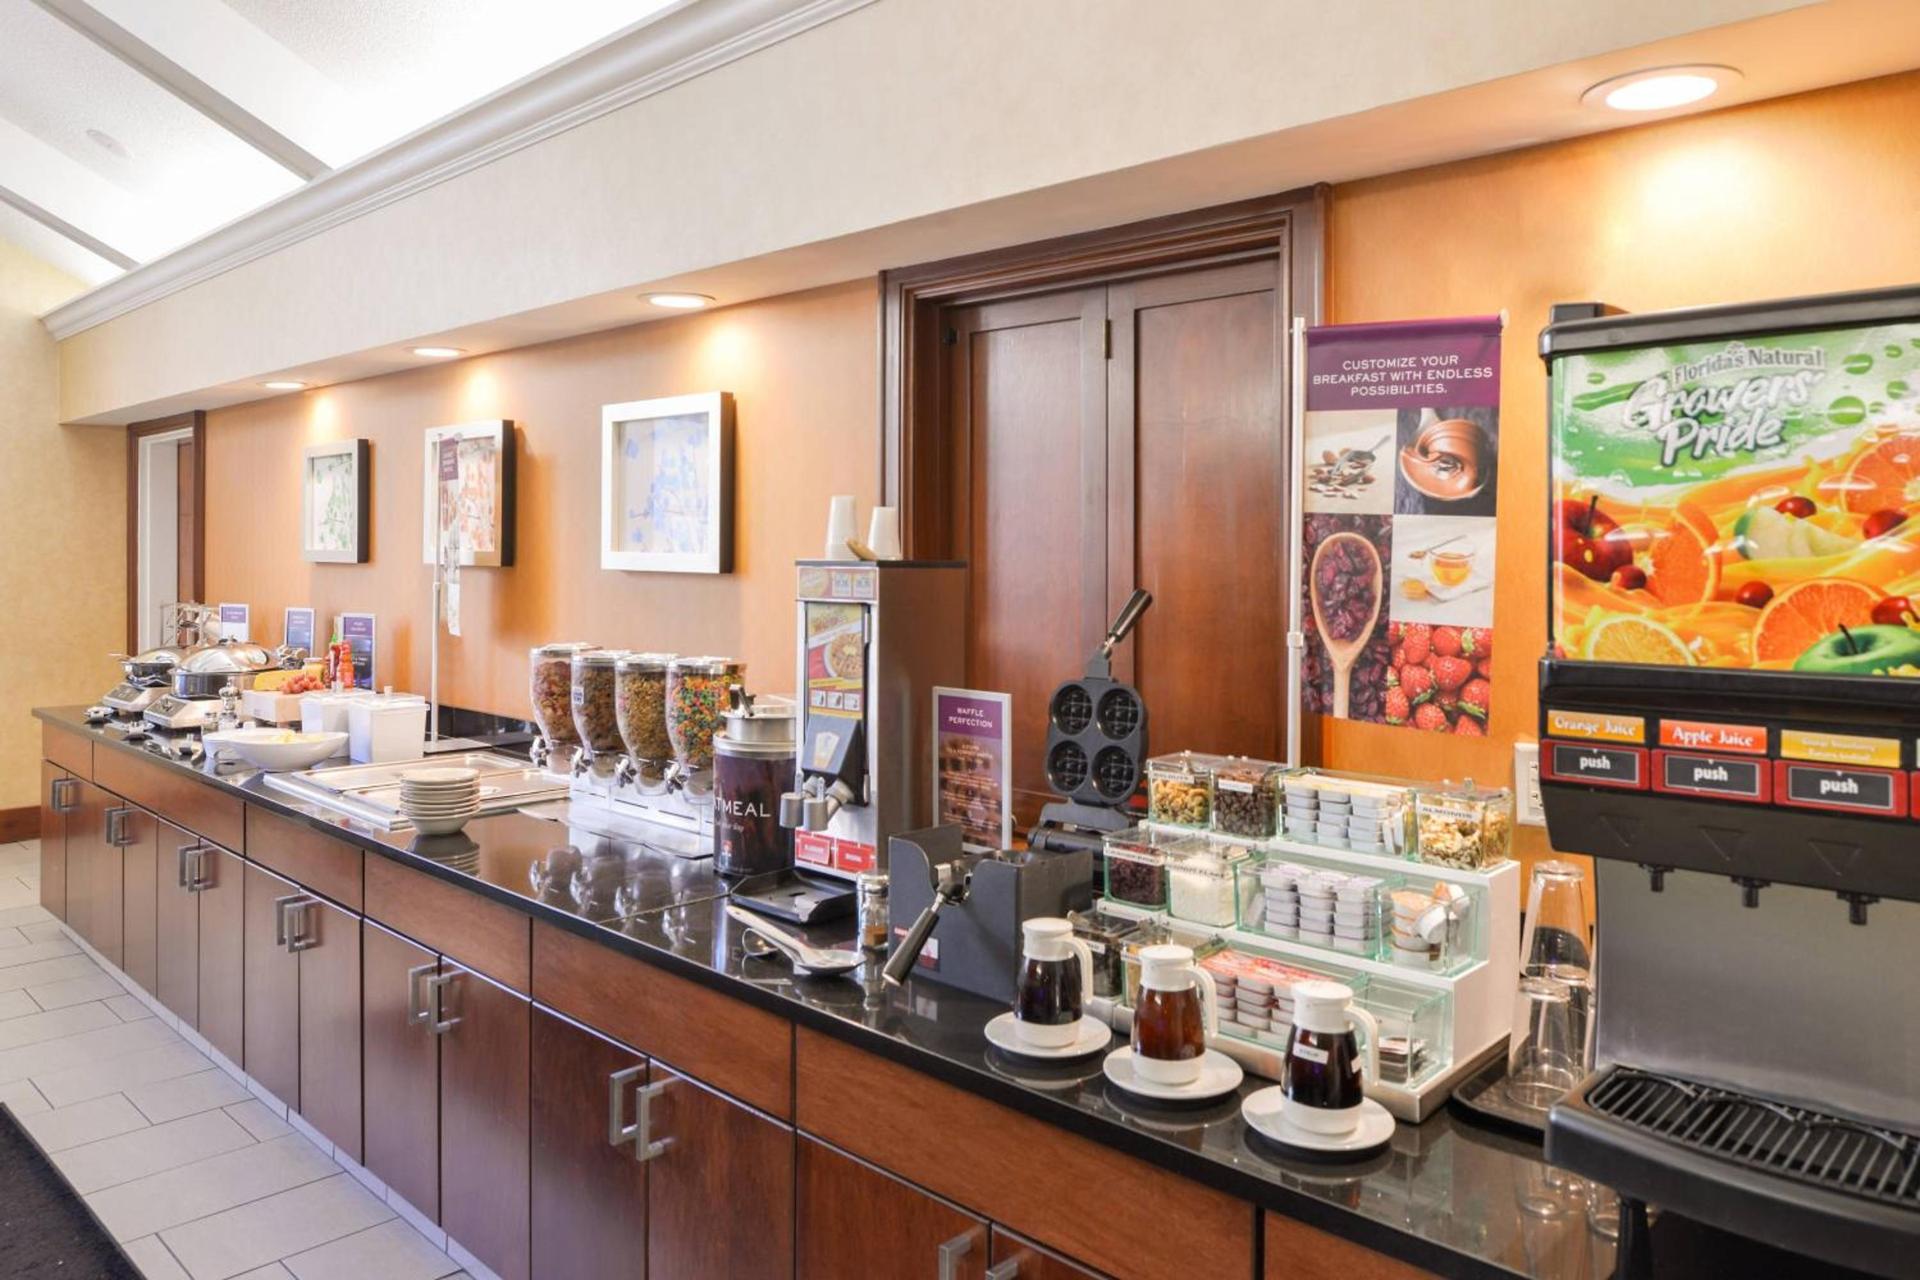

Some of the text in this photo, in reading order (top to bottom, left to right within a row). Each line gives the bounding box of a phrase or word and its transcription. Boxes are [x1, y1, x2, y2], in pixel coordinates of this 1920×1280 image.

[1342, 355, 1459, 371] CUSTOMIZE YOUR
[1748, 348, 1823, 367] Natural
[1313, 367, 1493, 385] BREAKFAST WITH ENDLESS
[1351, 383, 1448, 397] POSSIBILITIES.
[1656, 408, 1785, 466] Pride
[957, 707, 984, 718] WAFFLE
[948, 716, 993, 729] PERFECTION
[1554, 717, 1636, 737] Orange Juice
[1672, 726, 1754, 747] Apple Juice
[1579, 755, 1612, 771] push
[1693, 766, 1729, 782] push
[1819, 776, 1859, 795] push
